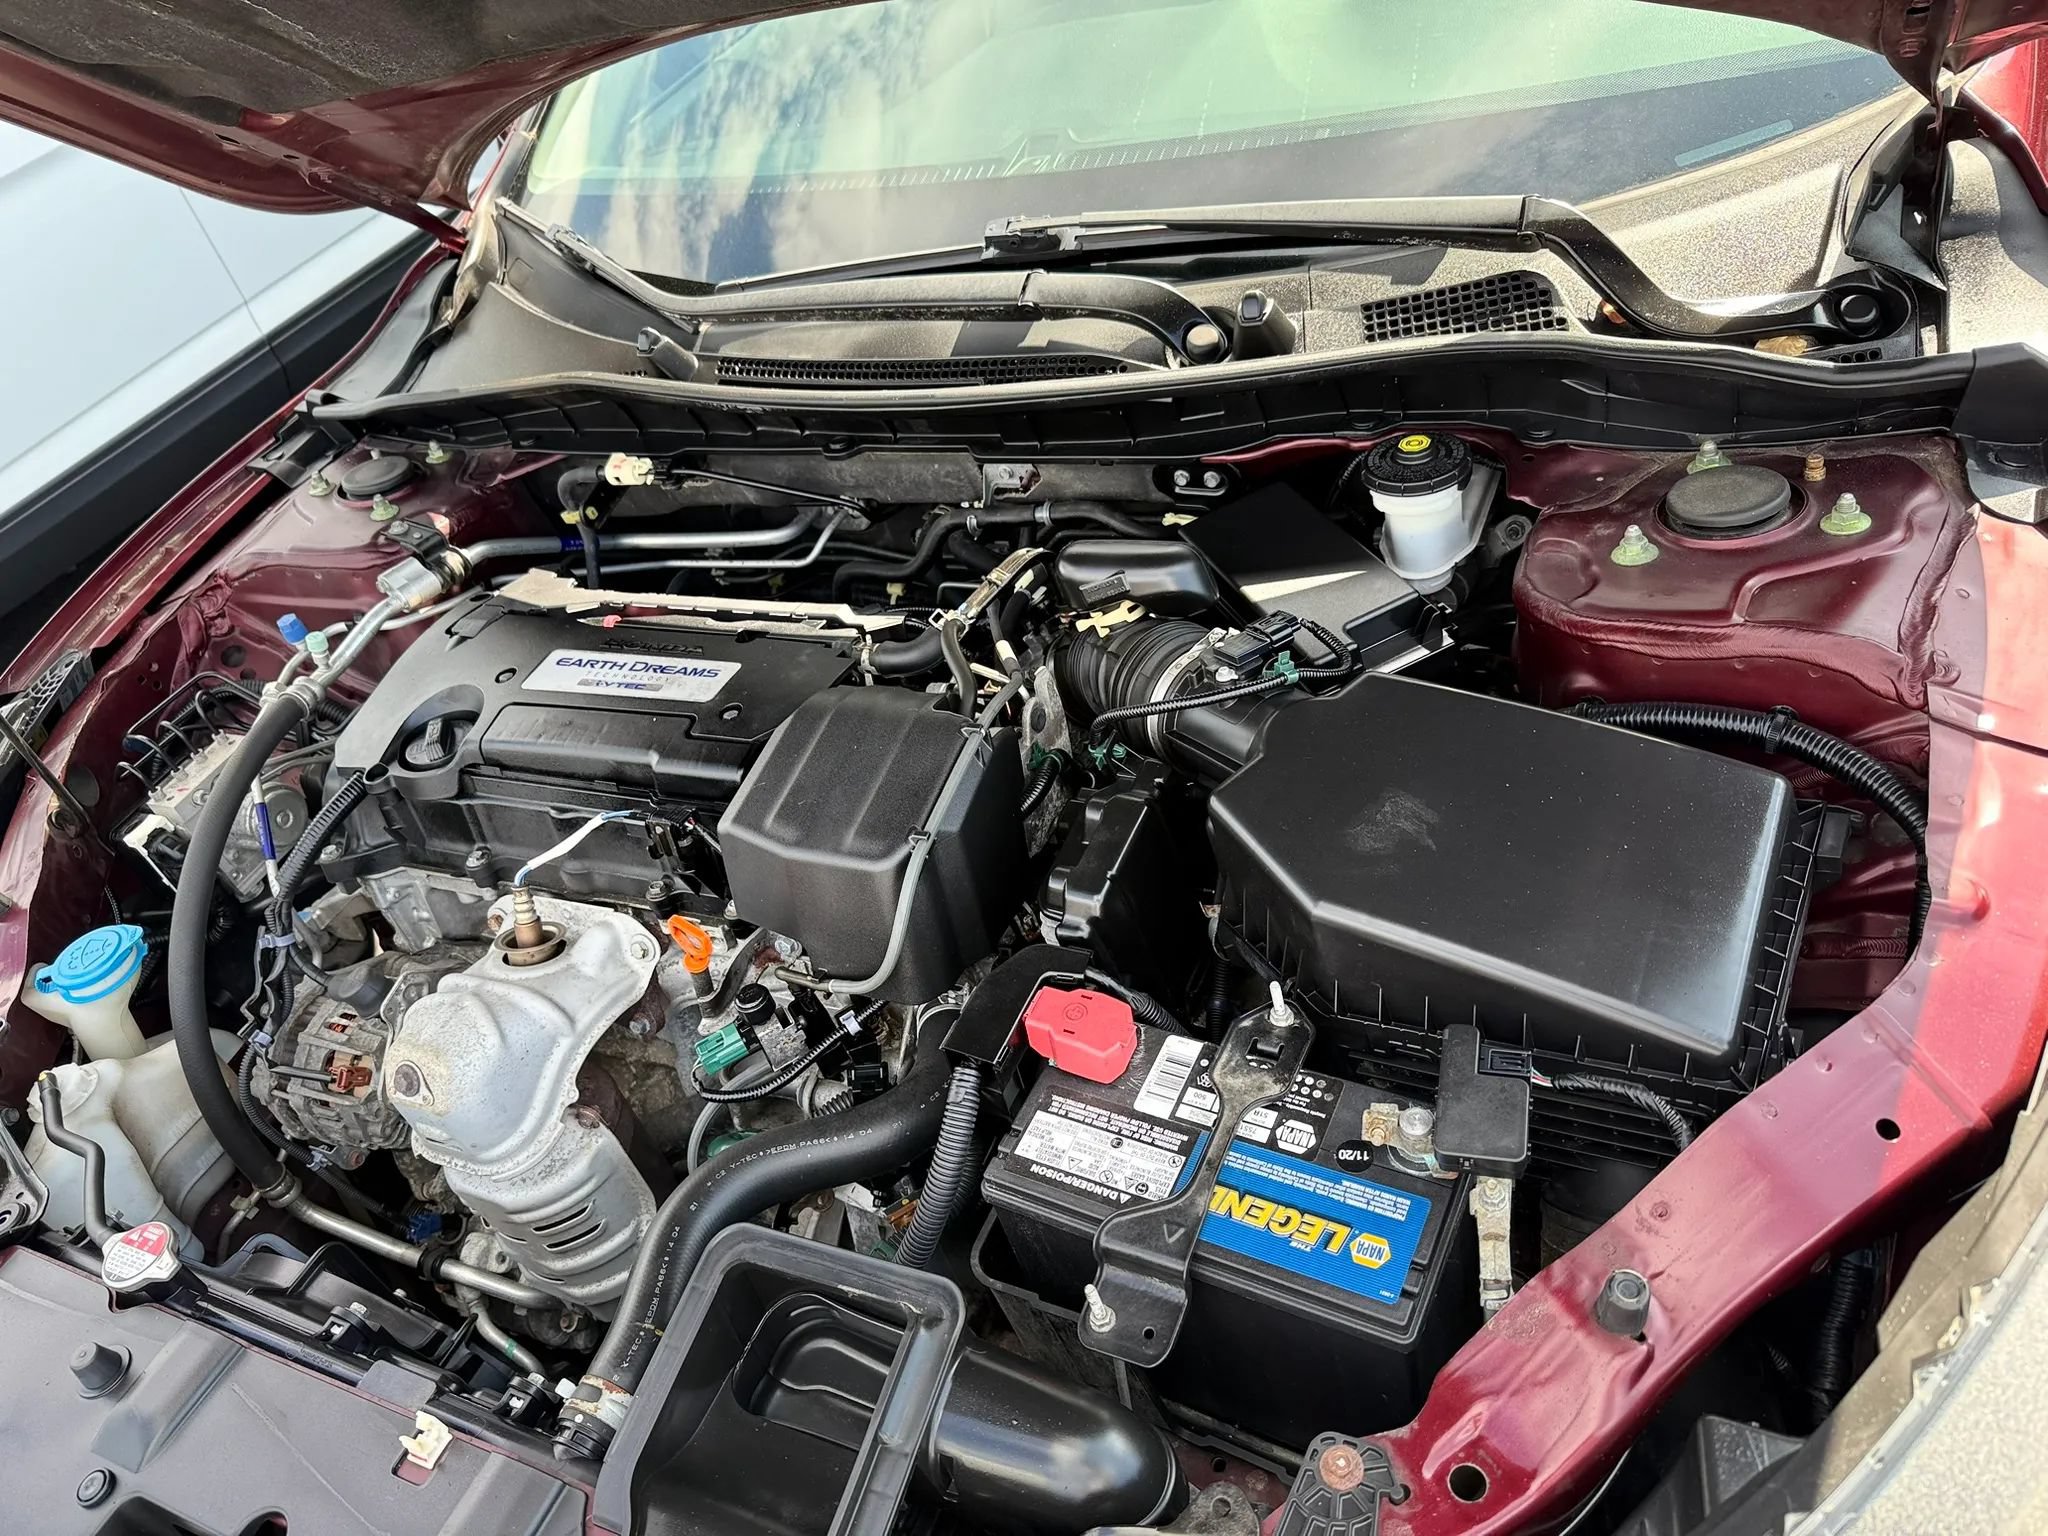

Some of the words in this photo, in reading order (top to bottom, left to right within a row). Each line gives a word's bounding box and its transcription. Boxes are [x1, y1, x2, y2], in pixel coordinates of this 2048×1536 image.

[556, 657, 625, 671] EARTH
[628, 661, 722, 678] DREAMS
[1279, 1125, 1311, 1147] NAPA
[1338, 1150, 1369, 1161] 11/20
[1028, 1162, 1119, 1200] DANGER/POISON
[1289, 1241, 1314, 1252] THE
[1356, 1239, 1386, 1261] NAPA
